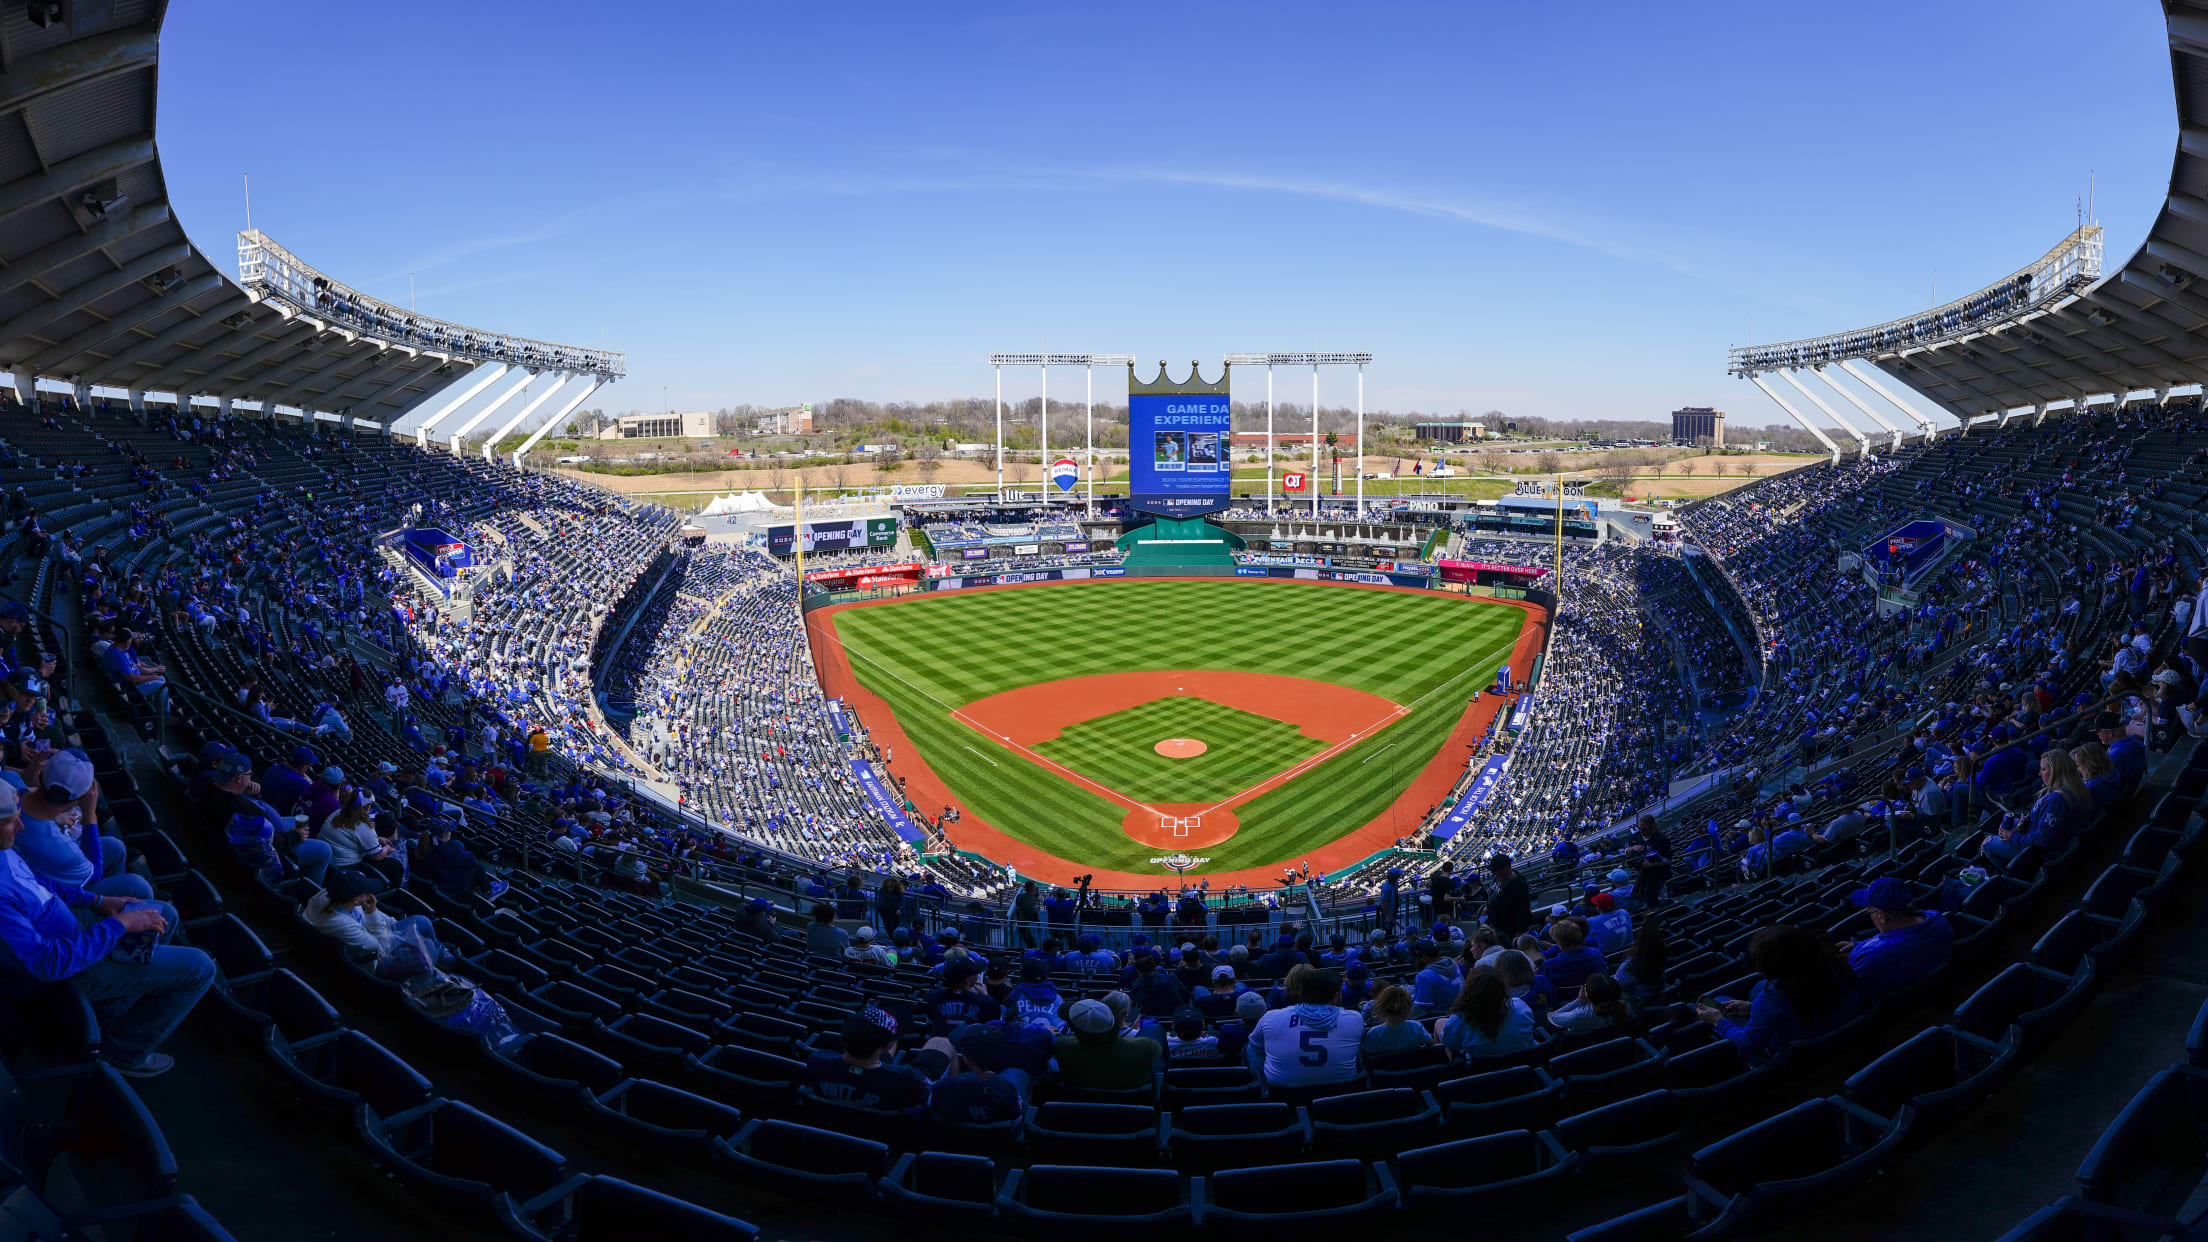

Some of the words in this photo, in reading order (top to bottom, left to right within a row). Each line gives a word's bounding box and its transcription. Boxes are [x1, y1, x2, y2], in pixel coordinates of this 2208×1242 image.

[1167, 404, 1208, 414] GAME
[1210, 404, 1229, 414] DA
[1154, 415, 1229, 425] EXPERIENC
[1285, 474, 1302, 488] QT
[904, 485, 945, 497] evergy
[1005, 489, 1024, 502] Lite
[1409, 500, 1438, 511] PATIO
[726, 516, 737, 525] 42
[812, 530, 846, 541] OPENING
[847, 529, 862, 539] DAY
[1491, 564, 1510, 572] BETTER
[1006, 574, 1034, 583] OPENING
[1035, 572, 1049, 581] DAY
[1344, 573, 1371, 582] OPENING
[1371, 575, 1384, 583] DAY
[1474, 786, 1486, 795] THE
[1150, 855, 1191, 864] OPENING
[1192, 856, 1211, 864] DAY
[1614, 927, 1628, 946] 7
[1075, 959, 1100, 968] PEREZ
[937, 1001, 963, 1017] WITT
[1016, 999, 1056, 1015] PEREZ
[1298, 1030, 1328, 1067] 5
[819, 1080, 857, 1101] WITT
